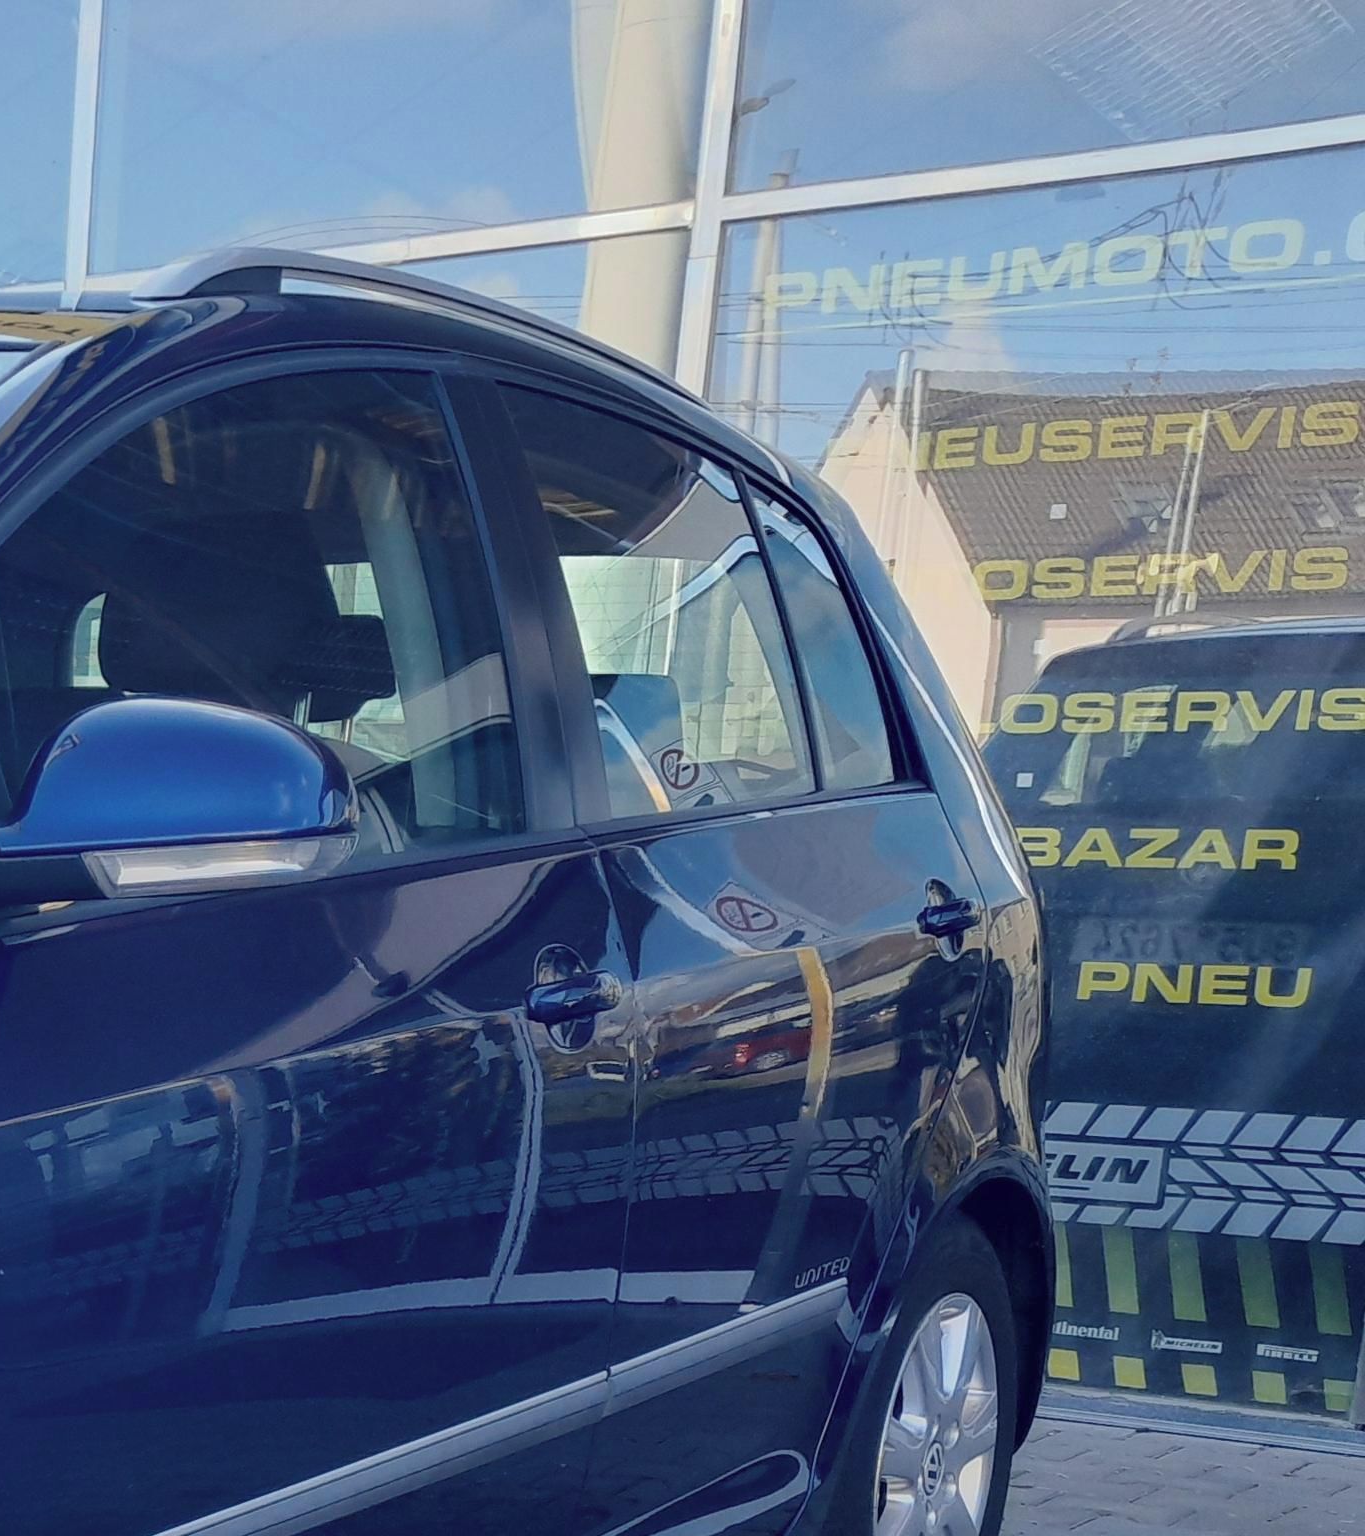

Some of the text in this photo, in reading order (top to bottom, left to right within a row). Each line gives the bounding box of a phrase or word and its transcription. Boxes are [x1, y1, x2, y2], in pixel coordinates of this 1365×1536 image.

[763, 210, 1365, 320] PNEUMOTO.
[1016, 827, 1301, 870] BAZAR
[1076, 961, 1313, 1008] PNEU
[794, 1256, 851, 1289] UNITED
[1053, 1321, 1119, 1341] tinental
[1164, 1338, 1220, 1350] MICHELIN
[1257, 1343, 1319, 1362] PIRELLI
